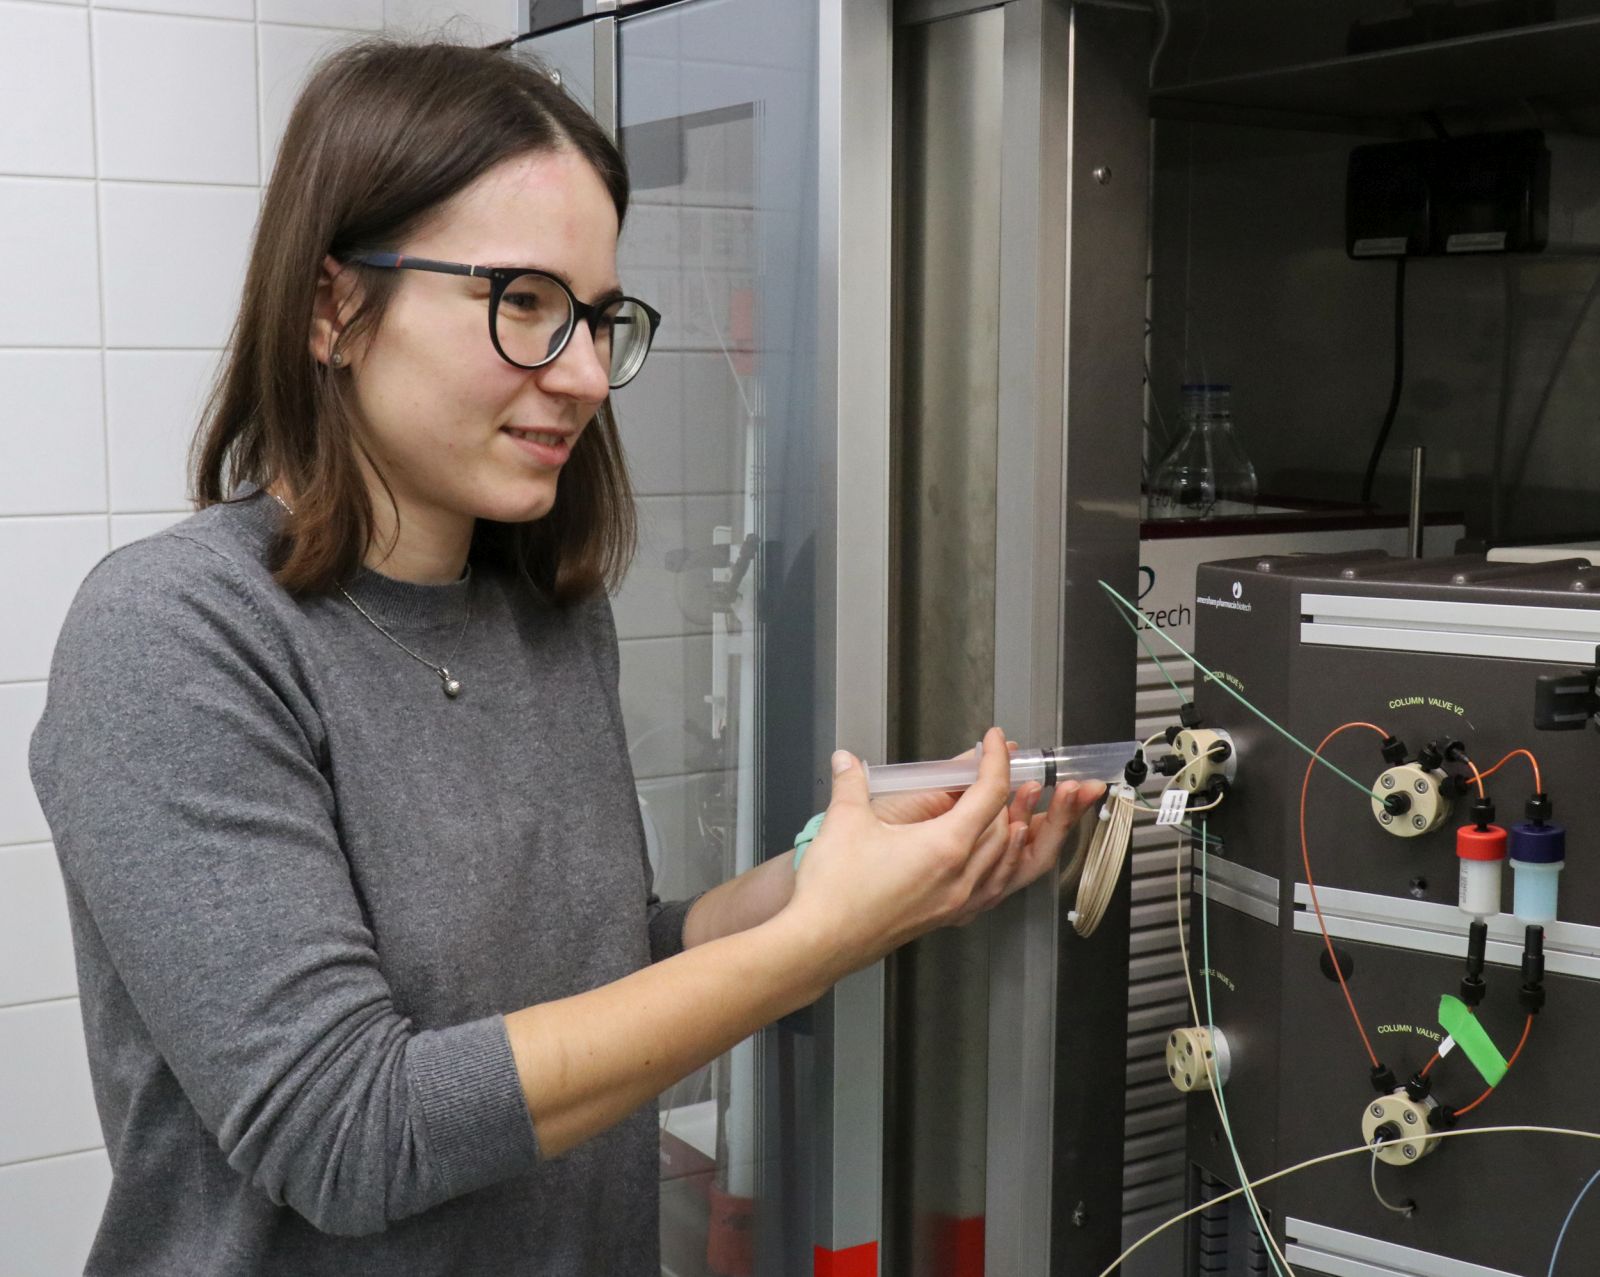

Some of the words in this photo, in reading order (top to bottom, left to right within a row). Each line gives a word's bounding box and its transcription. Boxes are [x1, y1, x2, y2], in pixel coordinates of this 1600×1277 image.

[1389, 697, 1424, 709] COLUMN
[1428, 697, 1453, 710] VALVE
[1454, 704, 1464, 715] V2
[1377, 1024, 1412, 1033] COLUMN
[1416, 1027, 1440, 1041] VALVE
